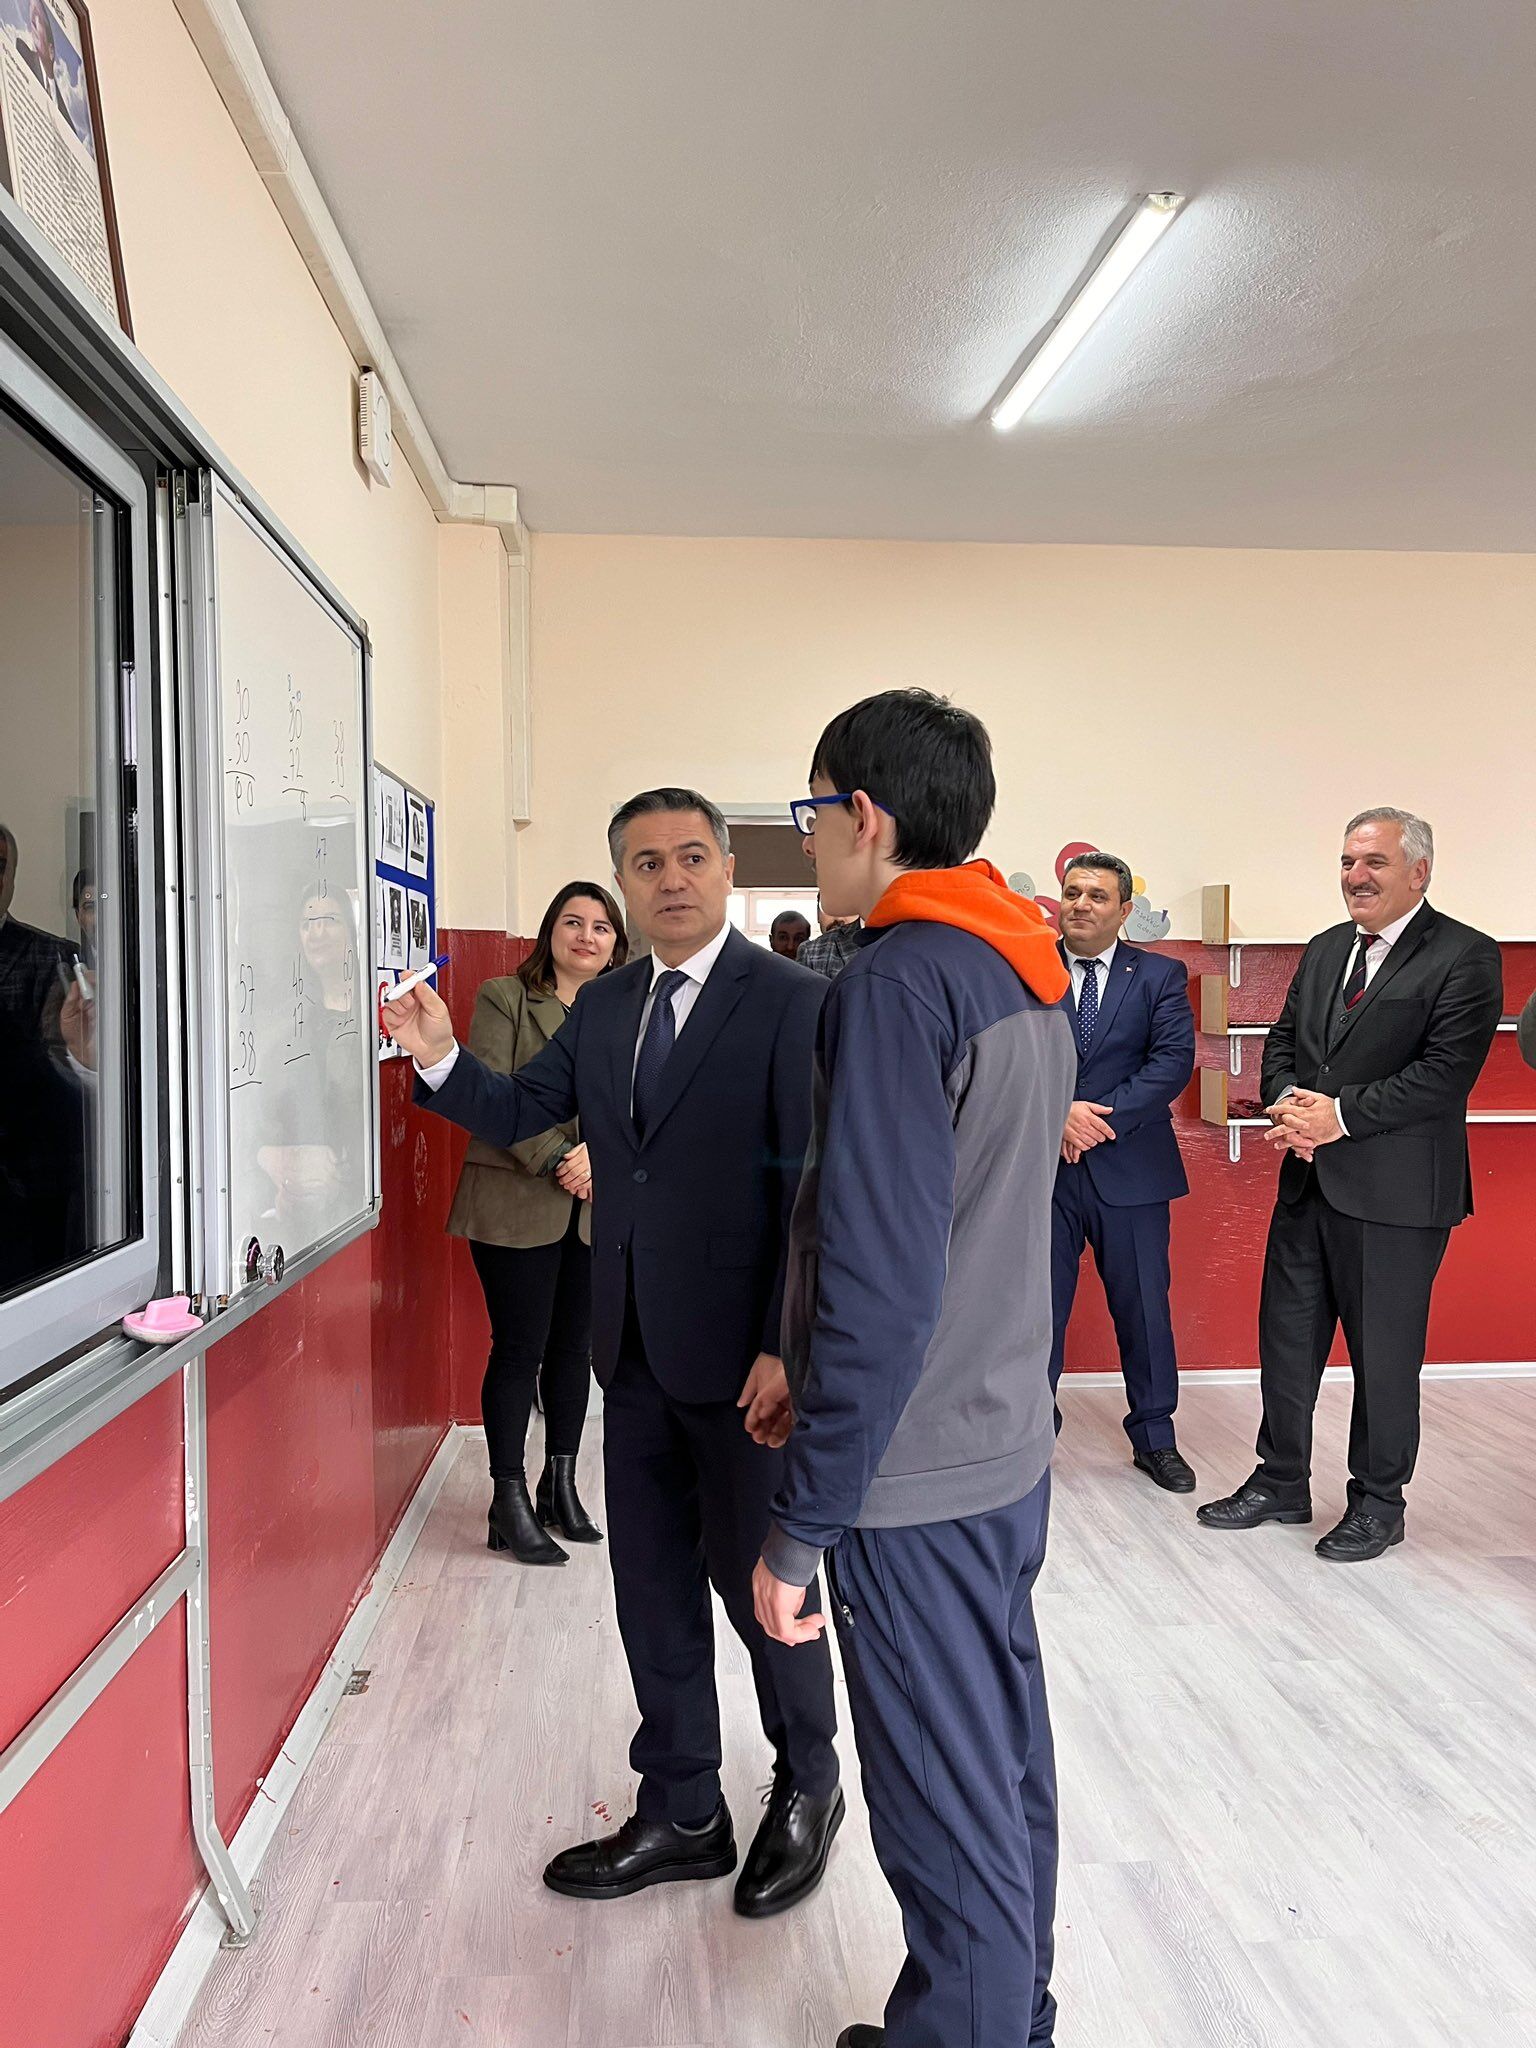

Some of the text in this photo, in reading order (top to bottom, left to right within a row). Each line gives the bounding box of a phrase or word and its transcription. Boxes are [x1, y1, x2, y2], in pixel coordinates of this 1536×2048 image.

[235, 678, 251, 725] 90
[333, 719, 345, 754] 38
[239, 963, 255, 1015] 57
